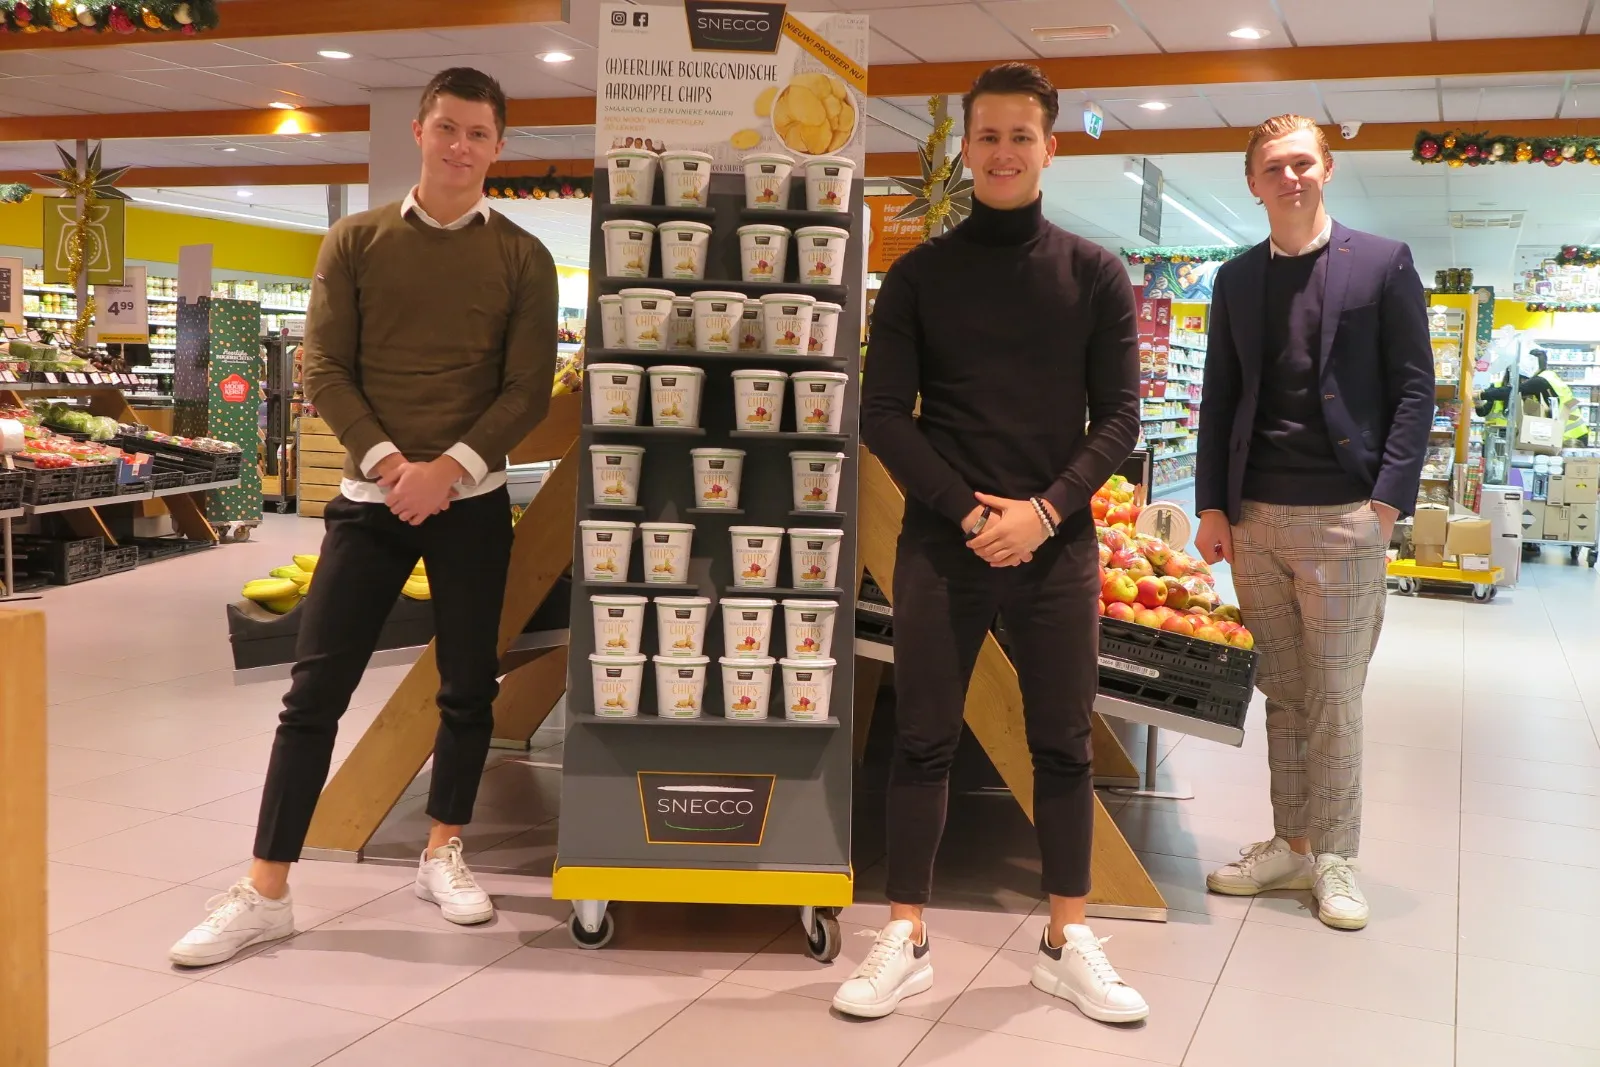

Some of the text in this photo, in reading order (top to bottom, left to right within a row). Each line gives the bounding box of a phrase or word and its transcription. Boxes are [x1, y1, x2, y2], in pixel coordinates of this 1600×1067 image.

[698, 18, 770, 32] SNECCO
[785, 22, 865, 81] NIEUW! PROBEER NU!
[605, 58, 778, 82] (H)EERLIJKE BOURGONDISCHE
[605, 82, 712, 103] AARDAPPEL CHIPS
[657, 798, 753, 814] SNECCO
